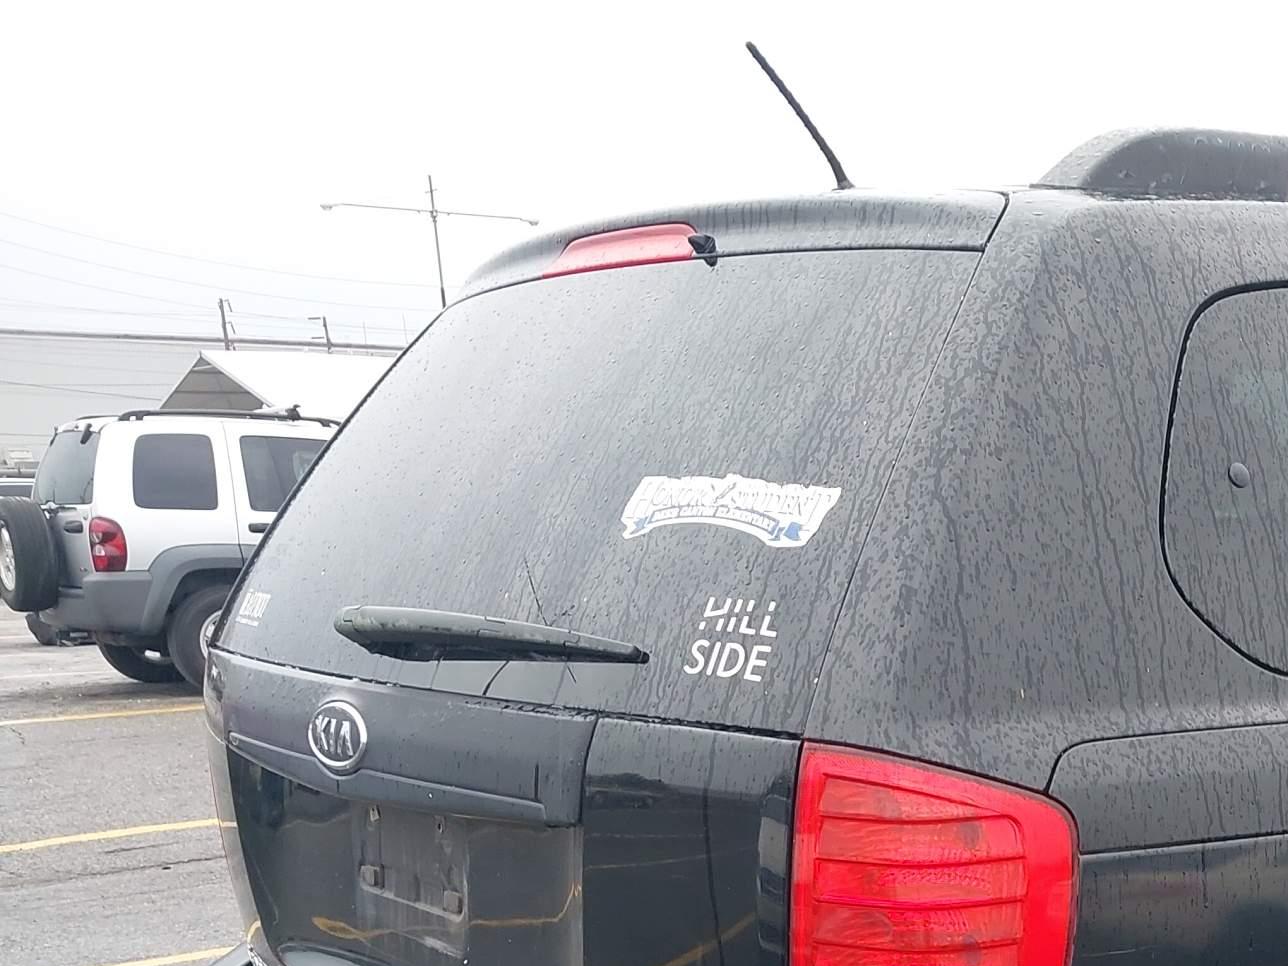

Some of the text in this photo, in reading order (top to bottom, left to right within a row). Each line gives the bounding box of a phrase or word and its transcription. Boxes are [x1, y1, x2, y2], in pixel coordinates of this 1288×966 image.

[699, 597, 777, 637] HILL
[683, 639, 772, 682] SIDE
[315, 714, 354, 757] KIA
